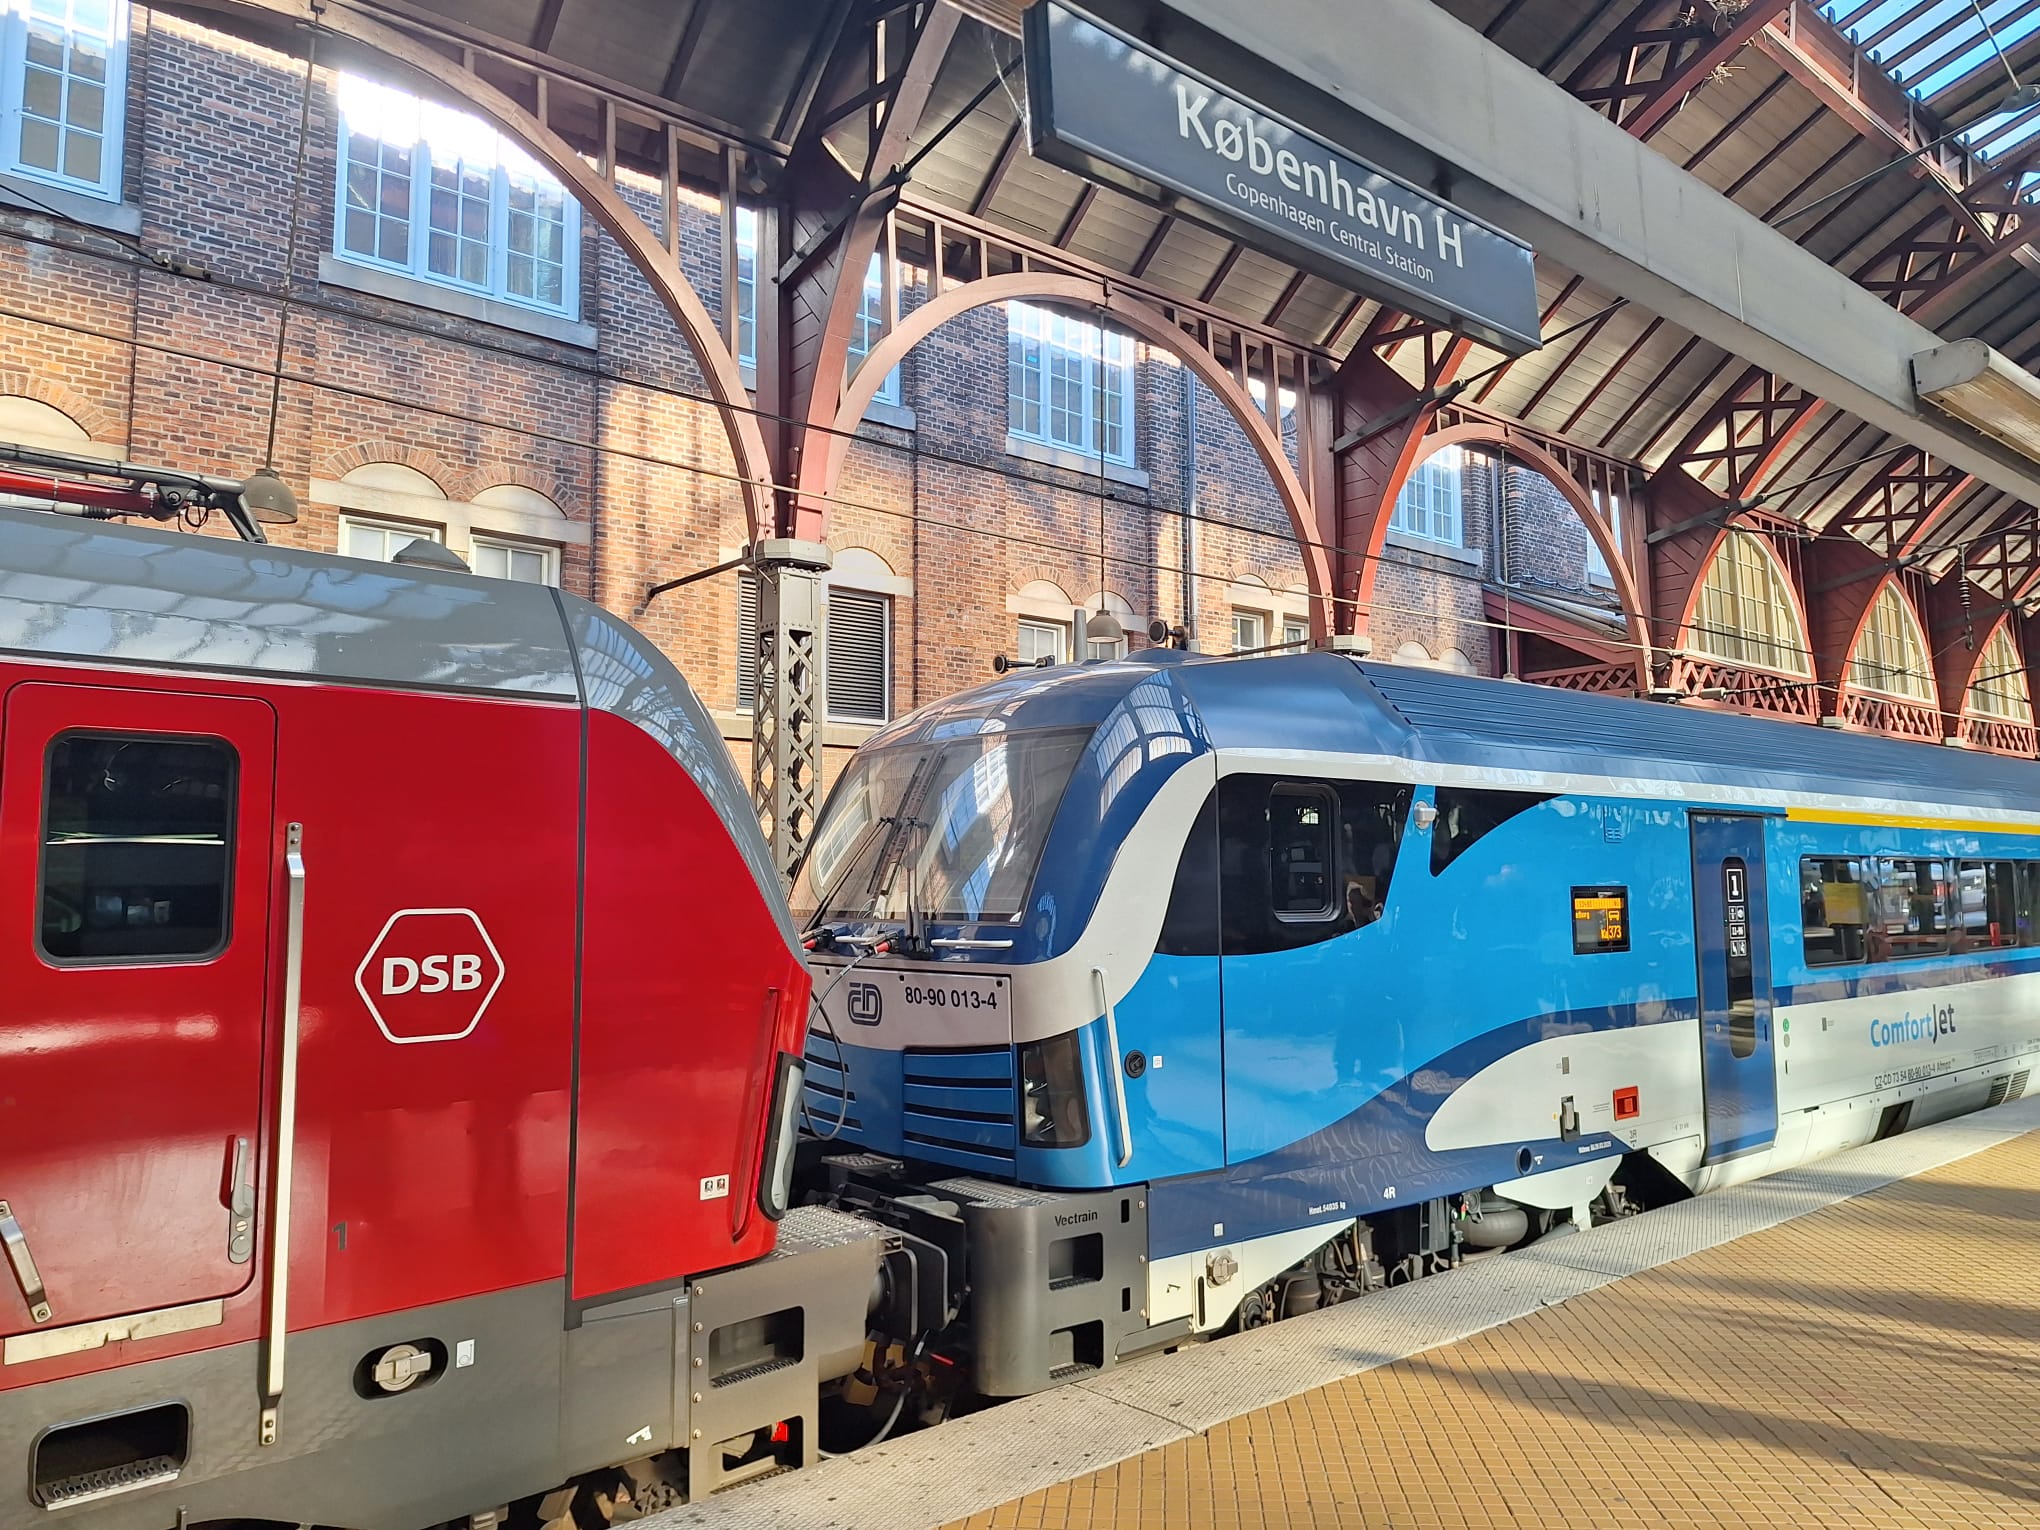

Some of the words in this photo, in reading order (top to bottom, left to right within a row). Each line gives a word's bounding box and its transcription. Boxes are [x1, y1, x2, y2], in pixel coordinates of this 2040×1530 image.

[1176, 84, 1424, 250] København
[1437, 215, 1465, 268] H
[1225, 173, 1326, 234] Copenhagen
[1330, 221, 1382, 260] Central
[1386, 246, 1434, 283] Station
[1731, 874, 1739, 896] 1
[382, 954, 483, 995] DSB
[905, 986, 946, 1007] 80-90
[951, 989, 997, 1010] 013-4
[1870, 1003, 1956, 1047] ComfortJet
[1383, 1186, 1396, 1200] 4R
[1054, 1209, 1099, 1227] Vectrain
[332, 1221, 347, 1251] 1
